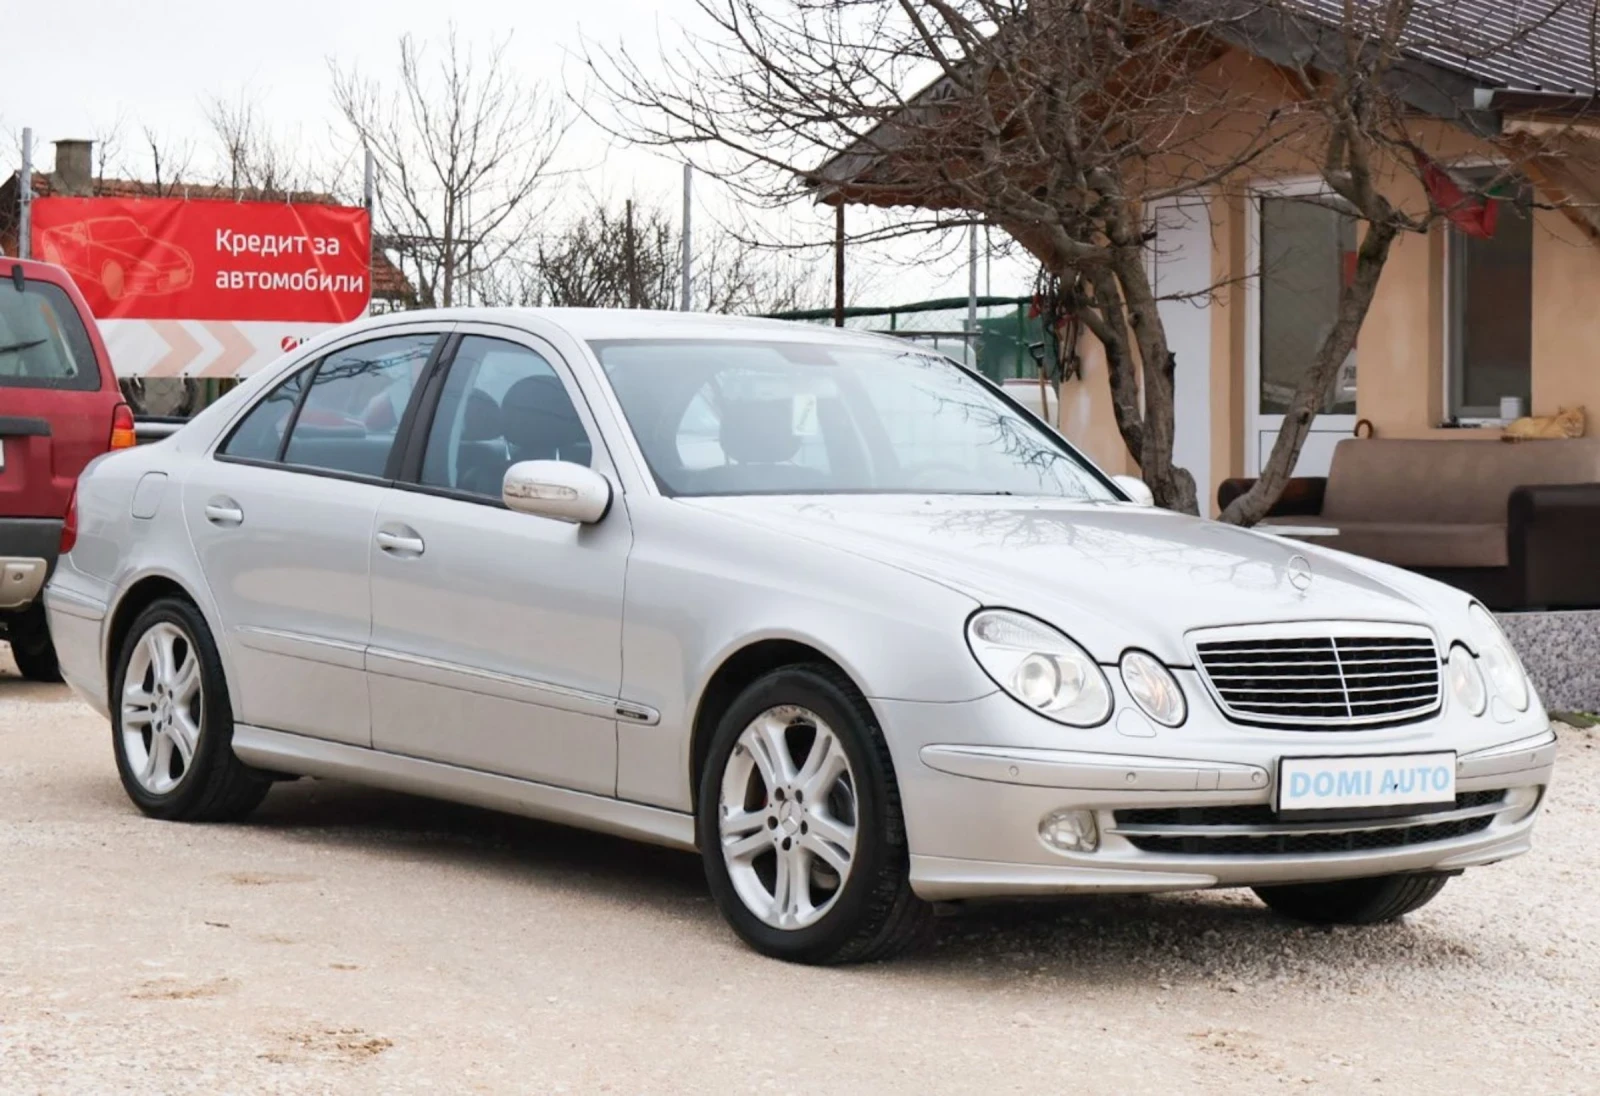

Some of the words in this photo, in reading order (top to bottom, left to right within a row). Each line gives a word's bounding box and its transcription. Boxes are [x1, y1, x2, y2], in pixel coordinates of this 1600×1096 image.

[216, 228, 308, 257] Кредит
[313, 237, 340, 255] за
[215, 268, 363, 293] автомобили
[1289, 770, 1372, 798] DOMI
[1379, 766, 1450, 793] AUTO
